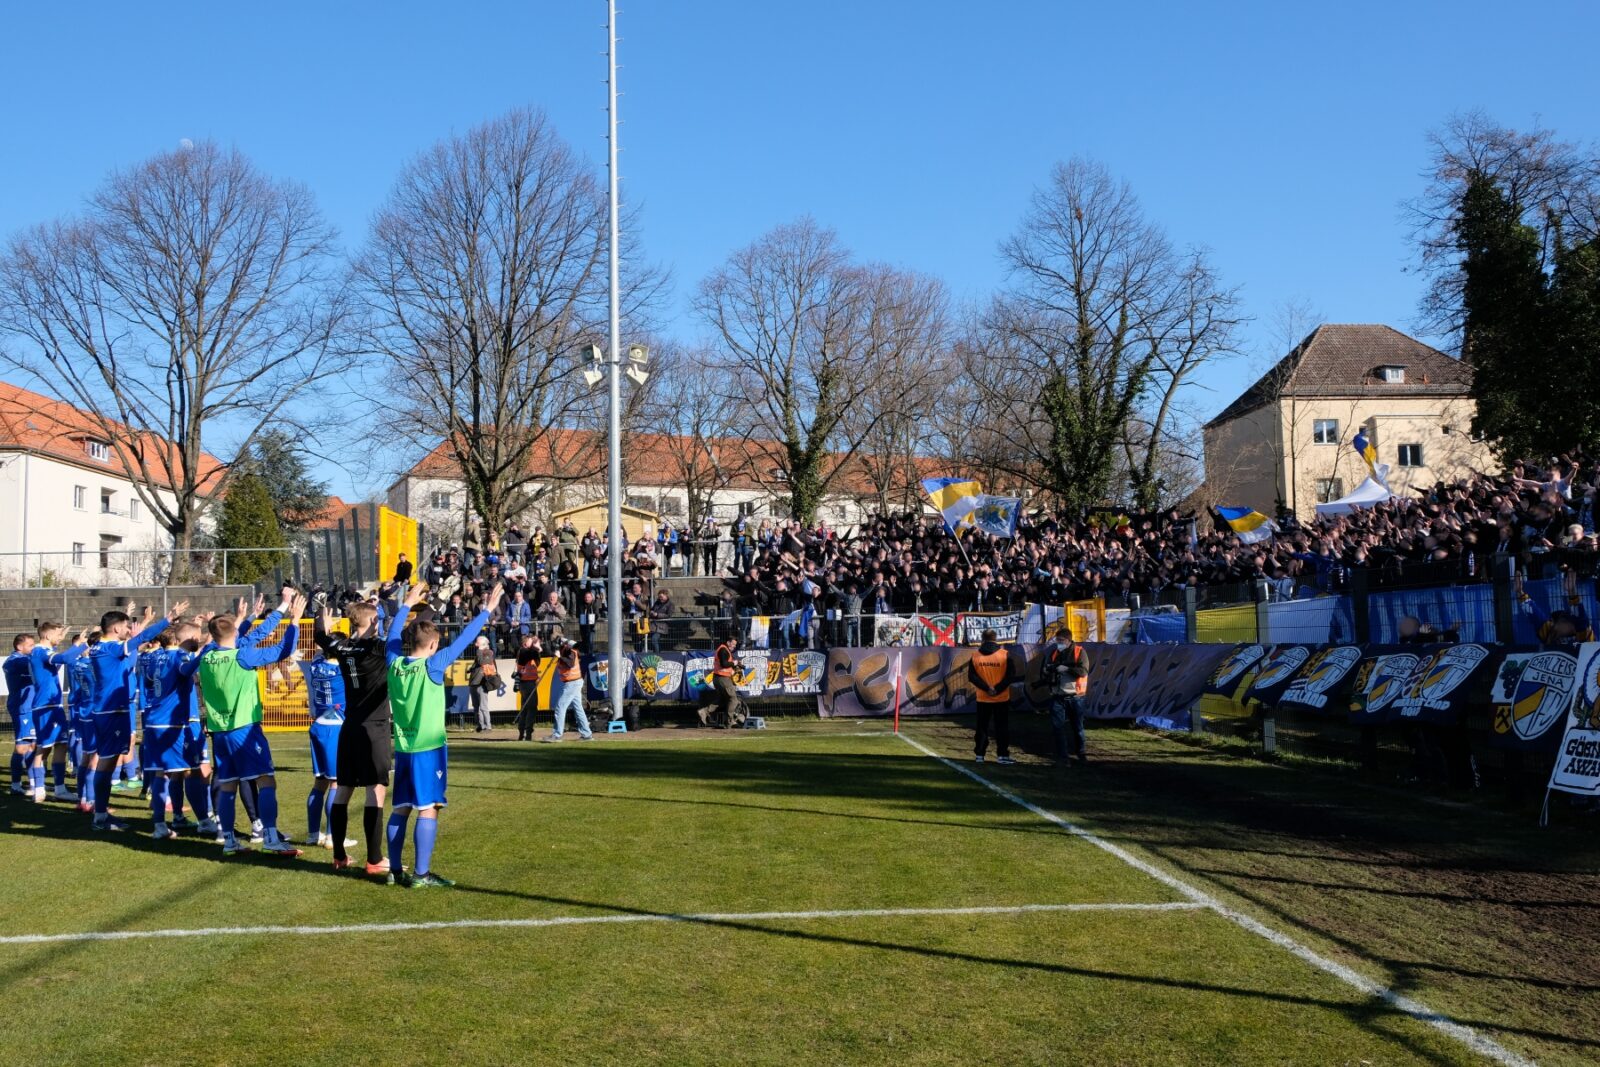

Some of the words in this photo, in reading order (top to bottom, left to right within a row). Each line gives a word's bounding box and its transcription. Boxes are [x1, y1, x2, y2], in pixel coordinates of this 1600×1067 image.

[966, 613, 1020, 628] REFUGEES
[1532, 656, 1553, 671] CARL
[1532, 671, 1564, 688] JENA
[1563, 757, 1600, 777] AWA
